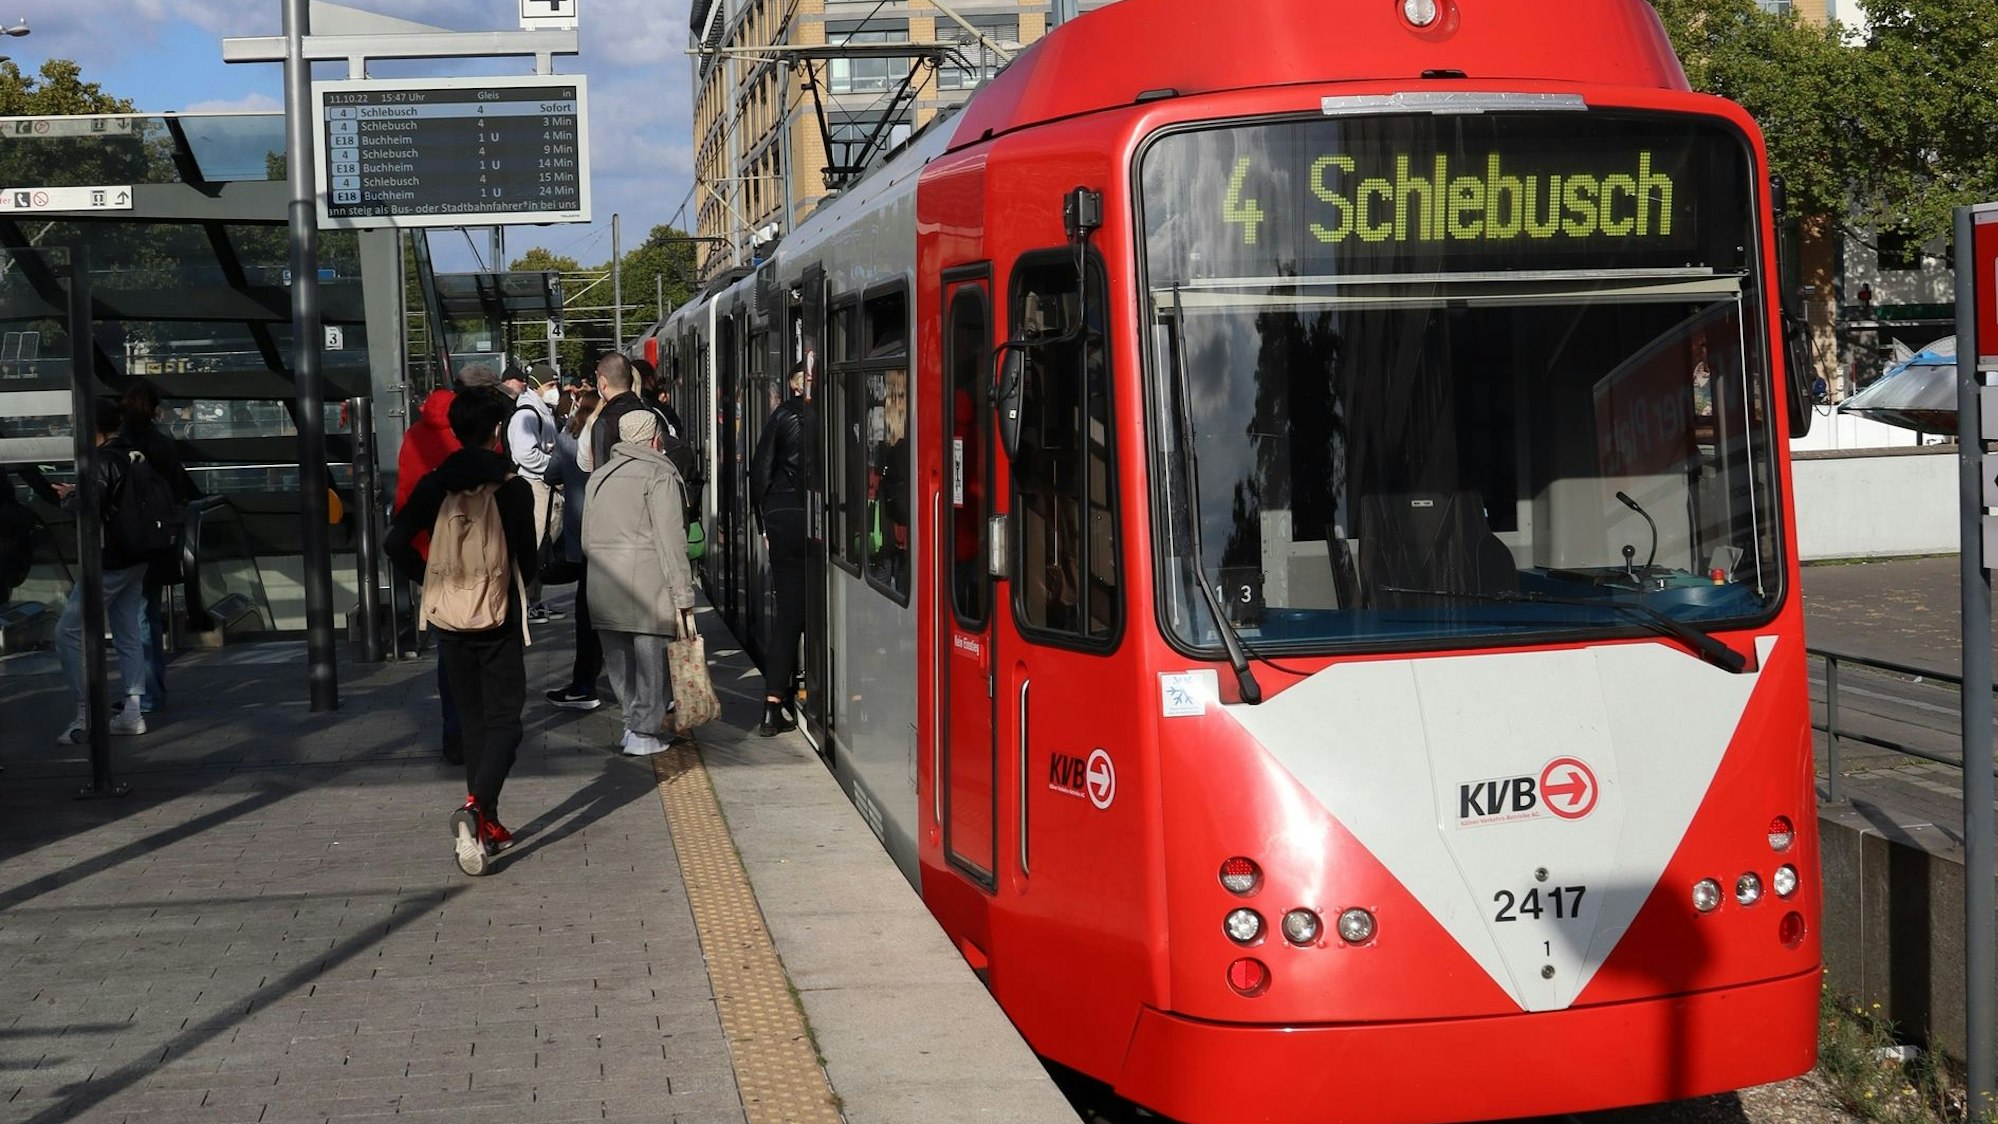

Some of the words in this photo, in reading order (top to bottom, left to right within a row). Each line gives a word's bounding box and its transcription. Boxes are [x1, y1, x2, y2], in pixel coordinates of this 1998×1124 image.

[330, 94, 368, 104] 11.10.22
[381, 94, 406, 102] 15:47
[408, 93, 426, 102] Uhr
[477, 91, 500, 100] Gleis
[562, 90, 571, 98] in
[340, 109, 347, 118] 4
[360, 107, 418, 117] Schlebusch
[477, 106, 484, 114] 4
[540, 104, 572, 112] Sofort
[340, 122, 347, 132] 4
[361, 121, 418, 131] Schlebusch
[478, 118, 484, 128] 4
[543, 117, 550, 126] 3
[552, 116, 572, 126] Min
[336, 136, 354, 146] E18
[362, 135, 412, 145] Buchheim
[479, 133, 484, 142] 1
[490, 132, 500, 142] U
[544, 131, 550, 140] 4
[552, 130, 572, 140] Min
[342, 151, 348, 160] 4
[362, 148, 418, 159] Schlebusch
[478, 147, 486, 156] 4
[544, 145, 550, 154] 9
[553, 144, 573, 154] Min
[336, 164, 355, 173] E18
[363, 162, 414, 173] Buchheim
[480, 160, 486, 170] 1
[492, 160, 500, 170] U
[538, 159, 550, 168] 14
[554, 158, 573, 168] Min
[343, 178, 350, 187] 4
[364, 176, 420, 187] Schlebusch
[480, 174, 486, 184] 4
[539, 173, 551, 182] 15
[554, 172, 574, 182] Min
[338, 192, 356, 201] E18
[364, 190, 414, 200] Buchheim
[481, 188, 486, 198] 1
[492, 188, 502, 198] U
[540, 186, 552, 196] 24
[554, 186, 574, 196] Min
[1223, 157, 1264, 245] 4
[1309, 152, 1673, 242] Schlebusch
[348, 206, 372, 216] steig
[374, 204, 388, 214] als
[391, 204, 413, 214] Bus-
[416, 204, 440, 214] oder
[540, 200, 556, 210] bei
[558, 200, 576, 209] uns
[552, 324, 562, 336] 4
[330, 333, 338, 345] 3
[1216, 585, 1222, 604] 1
[1240, 584, 1252, 603] 3
[1049, 752, 1086, 789] KVB
[1460, 777, 1537, 818] KVB
[1493, 886, 1586, 922] 2417
[1543, 940, 1550, 957] 1
